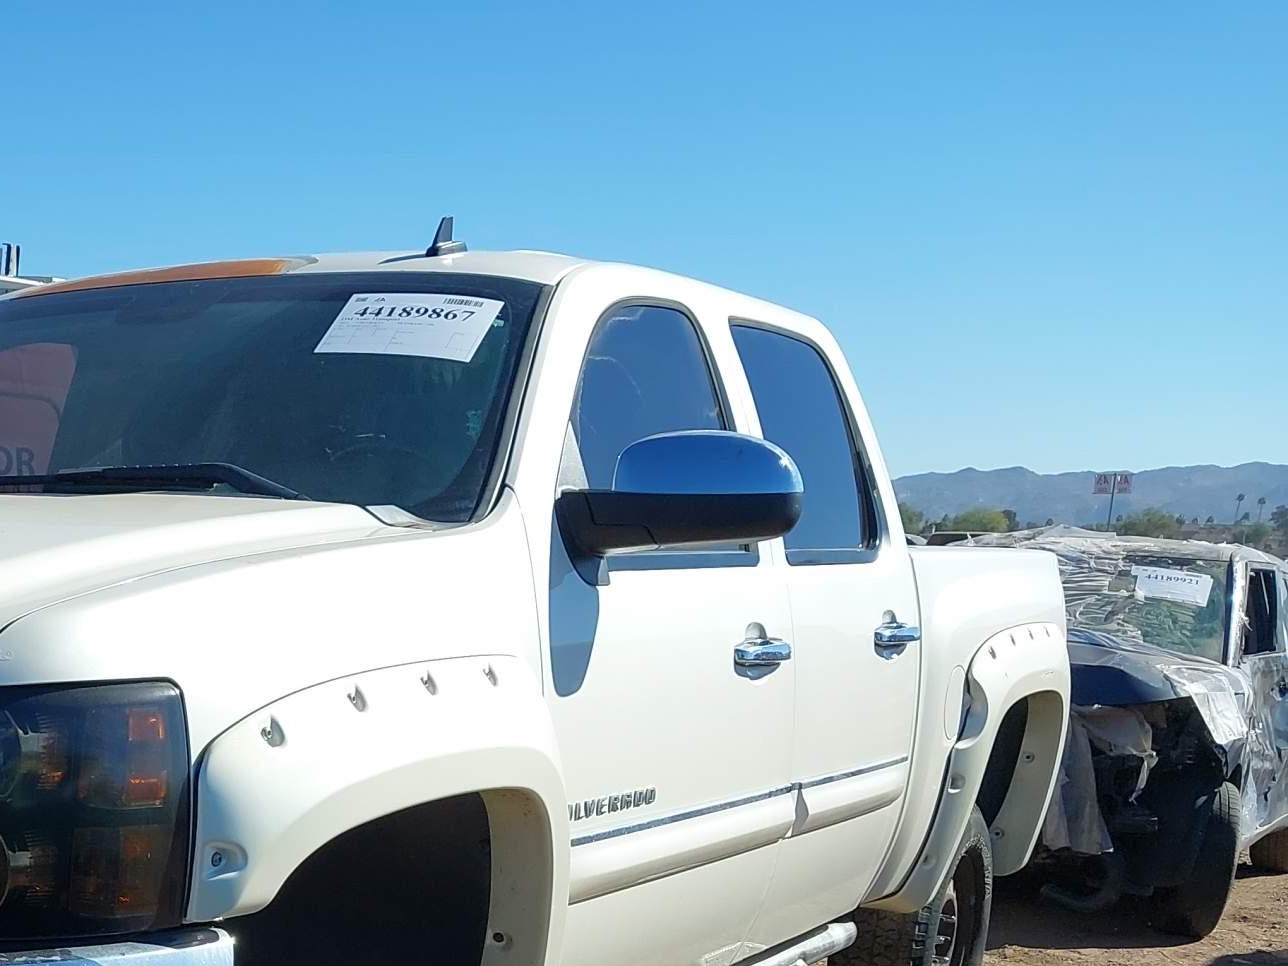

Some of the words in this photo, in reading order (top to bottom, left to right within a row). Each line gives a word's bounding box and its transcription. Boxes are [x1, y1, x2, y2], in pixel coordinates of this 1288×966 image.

[354, 305, 476, 322] 44189867
[1144, 573, 1200, 585] 44189921
[567, 787, 657, 821] ILVERADO
